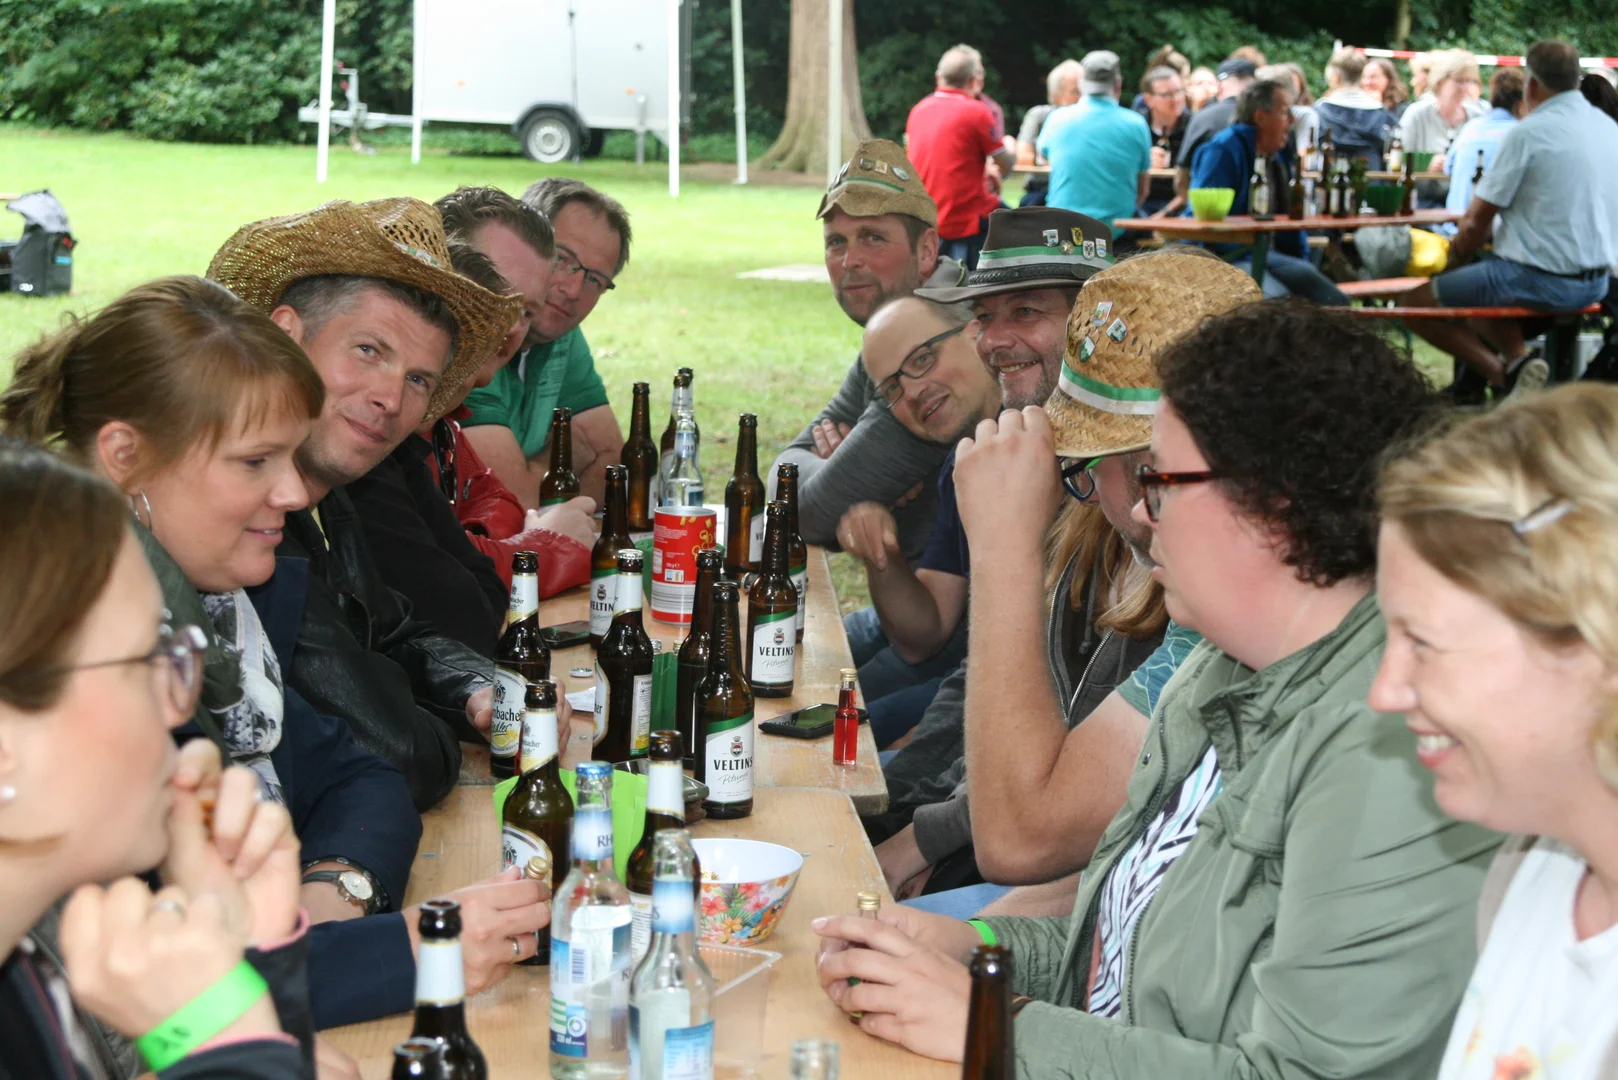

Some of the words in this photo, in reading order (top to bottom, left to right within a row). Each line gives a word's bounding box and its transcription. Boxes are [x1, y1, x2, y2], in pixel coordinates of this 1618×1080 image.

[592, 601, 614, 612] ELTIN
[759, 645, 794, 657] VELTINS
[713, 756, 753, 771] VELTINS
